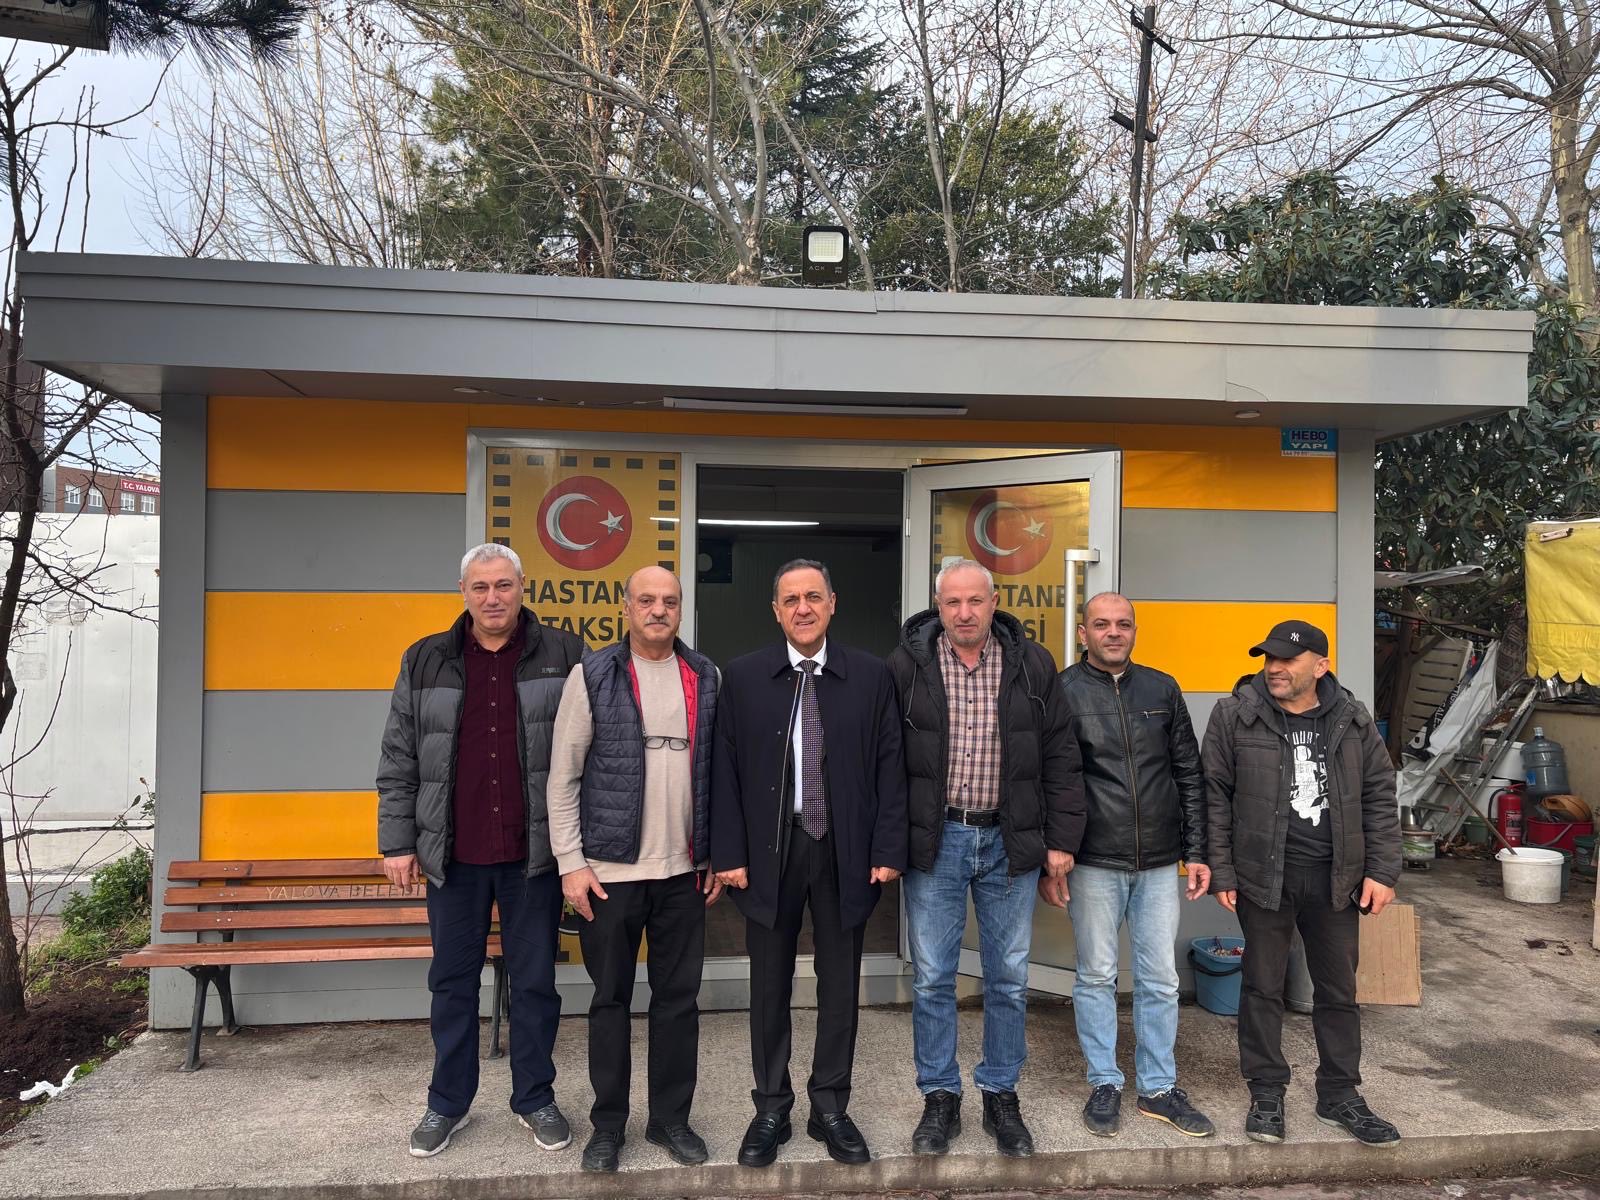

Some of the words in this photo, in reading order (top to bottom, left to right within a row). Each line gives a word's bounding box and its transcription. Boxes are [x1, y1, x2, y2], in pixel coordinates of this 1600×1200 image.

[1291, 430, 1328, 441] HEBO
[1290, 442, 1328, 450] YAPI
[123, 482, 135, 490] T.C.
[135, 484, 160, 493] YALOVA
[521, 580, 625, 605] HASTAN
[994, 584, 1066, 608] TANE
[266, 885, 340, 900] YALOVA
